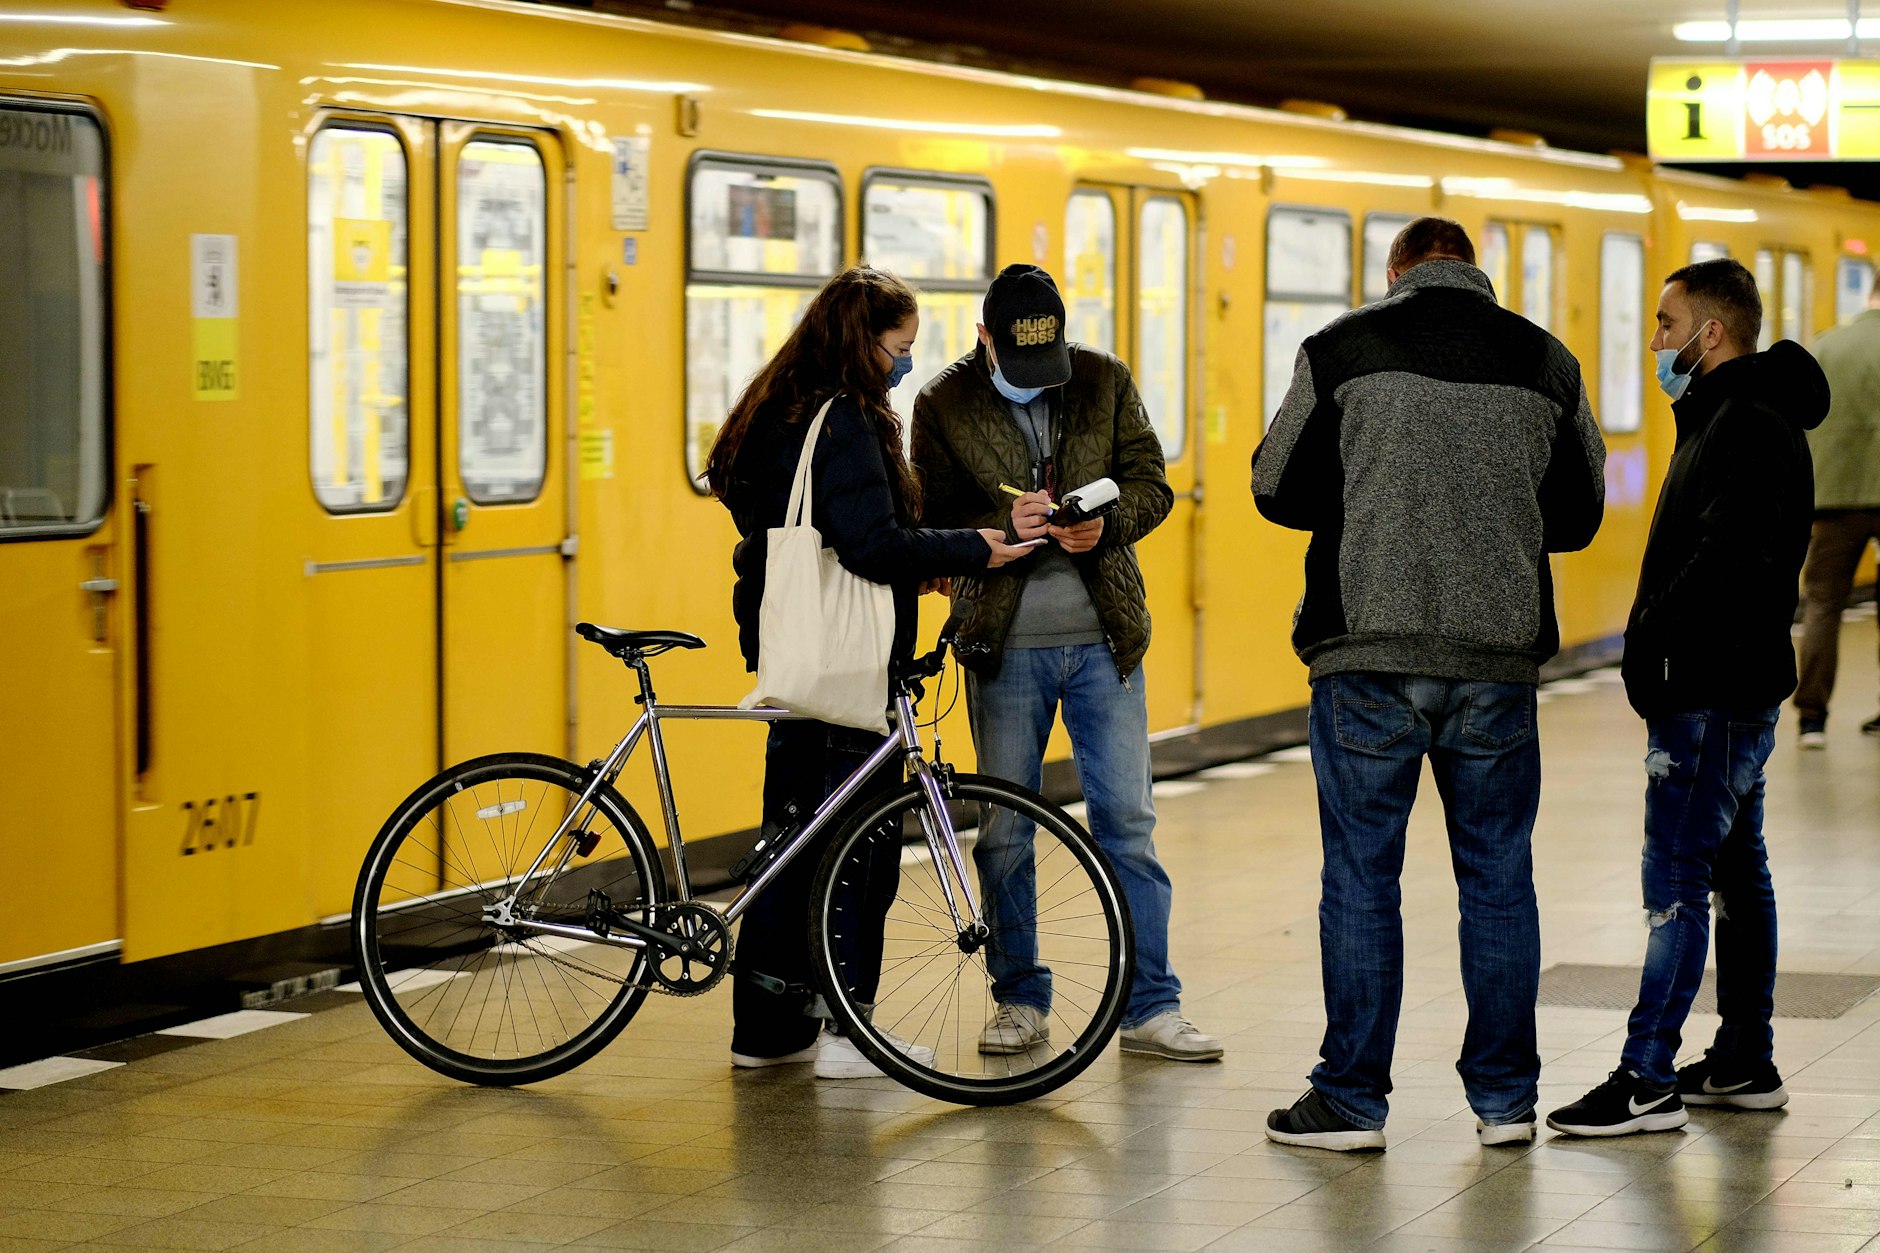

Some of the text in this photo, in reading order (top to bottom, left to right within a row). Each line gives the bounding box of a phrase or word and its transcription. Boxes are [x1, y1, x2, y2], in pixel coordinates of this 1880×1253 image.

[1761, 124, 1811, 150] SOS
[1016, 315, 1056, 333] HUGO
[1016, 329, 1056, 346] BOSS
[179, 792, 260, 856] 2607
